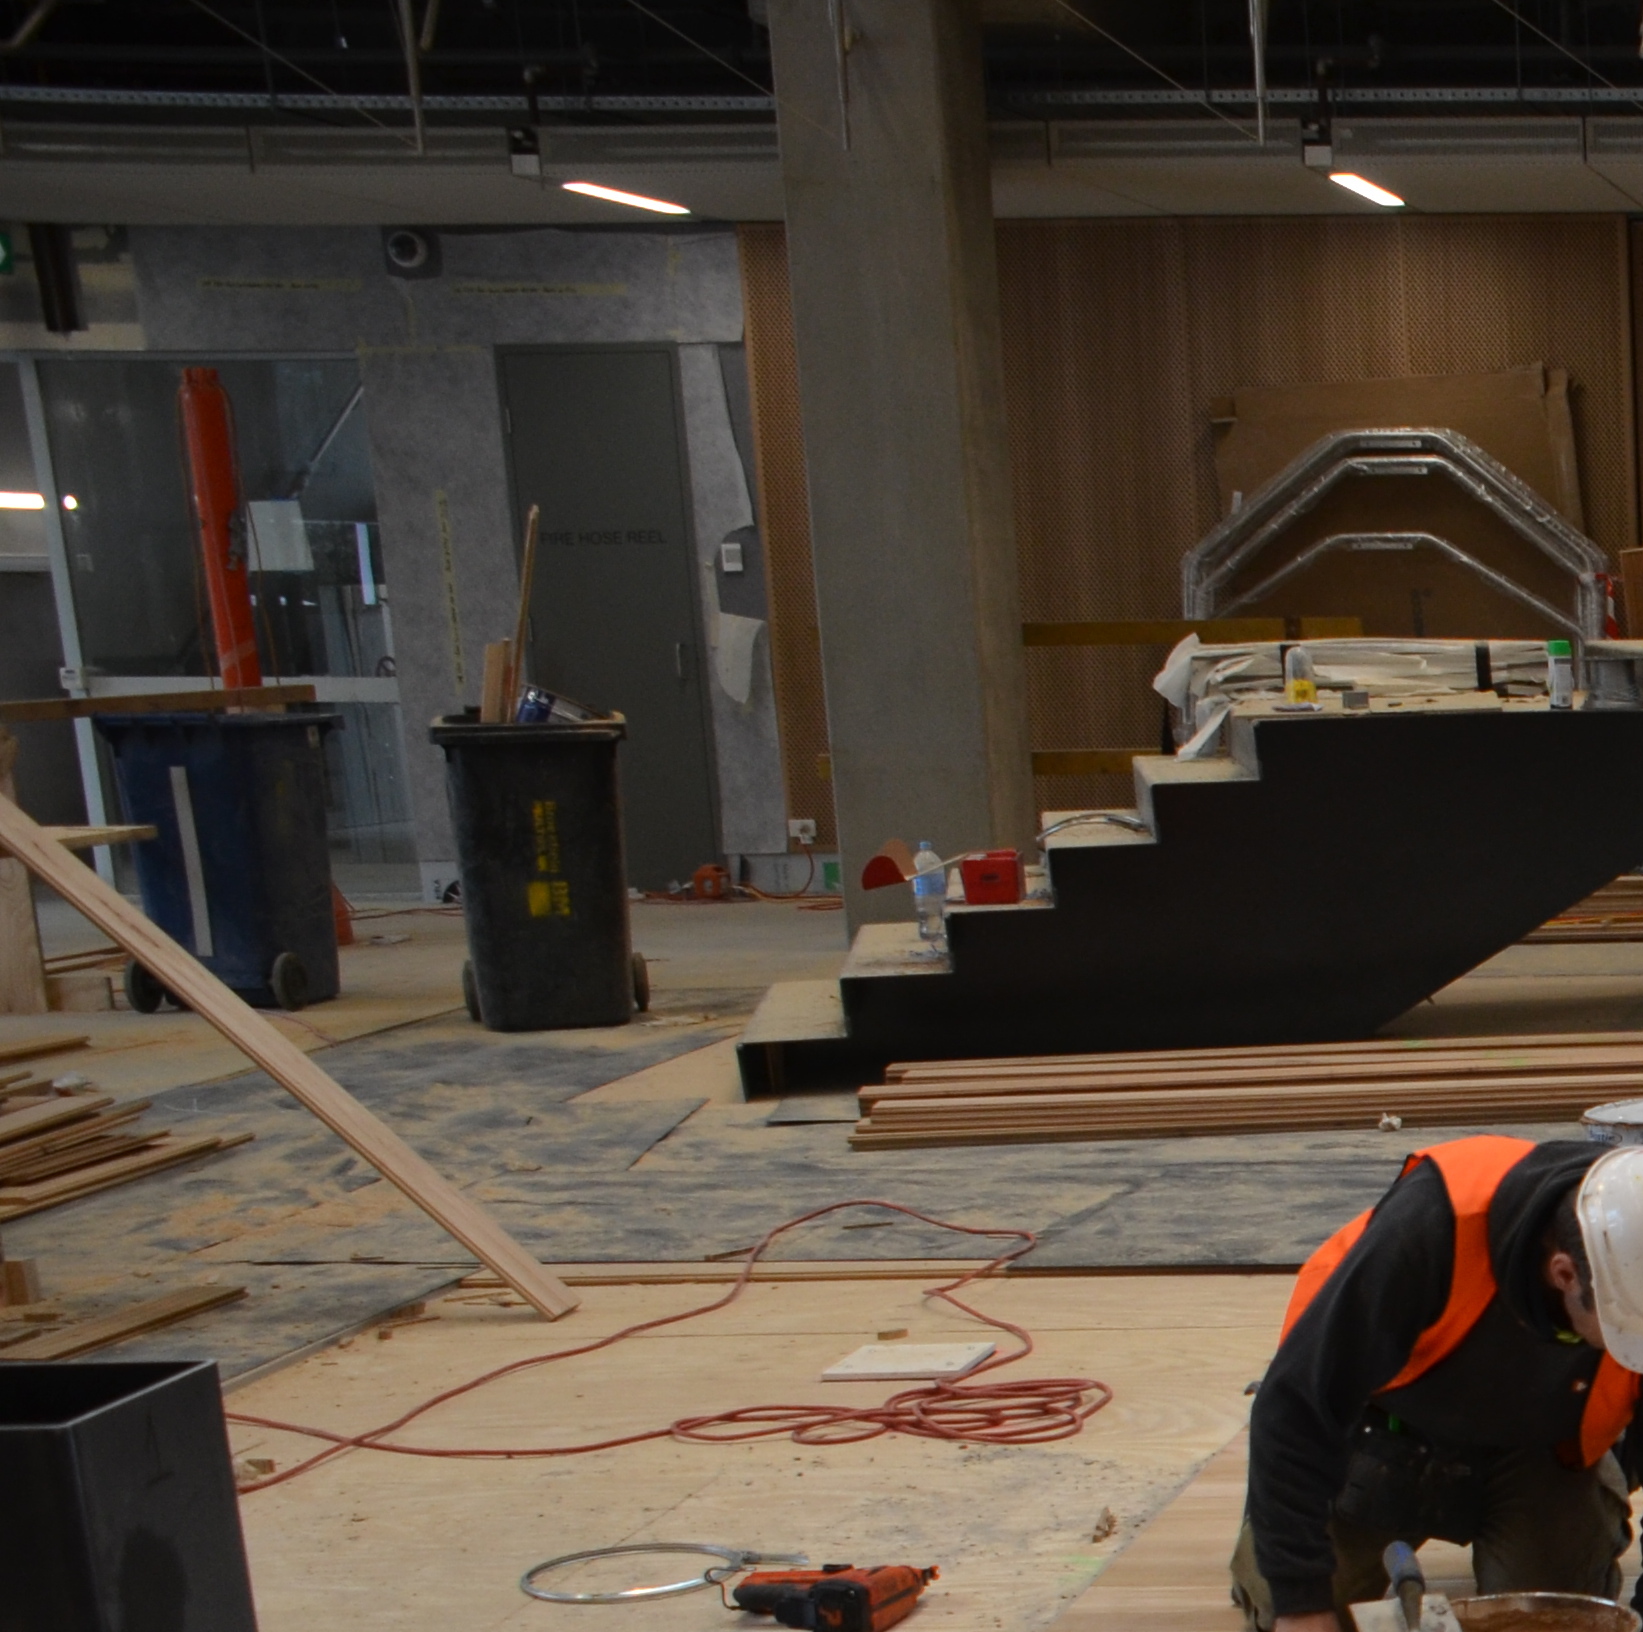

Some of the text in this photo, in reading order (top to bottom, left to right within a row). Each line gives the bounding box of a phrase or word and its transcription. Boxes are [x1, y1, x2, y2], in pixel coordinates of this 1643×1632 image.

[540, 529, 667, 546] FIRE HOSE REEL
